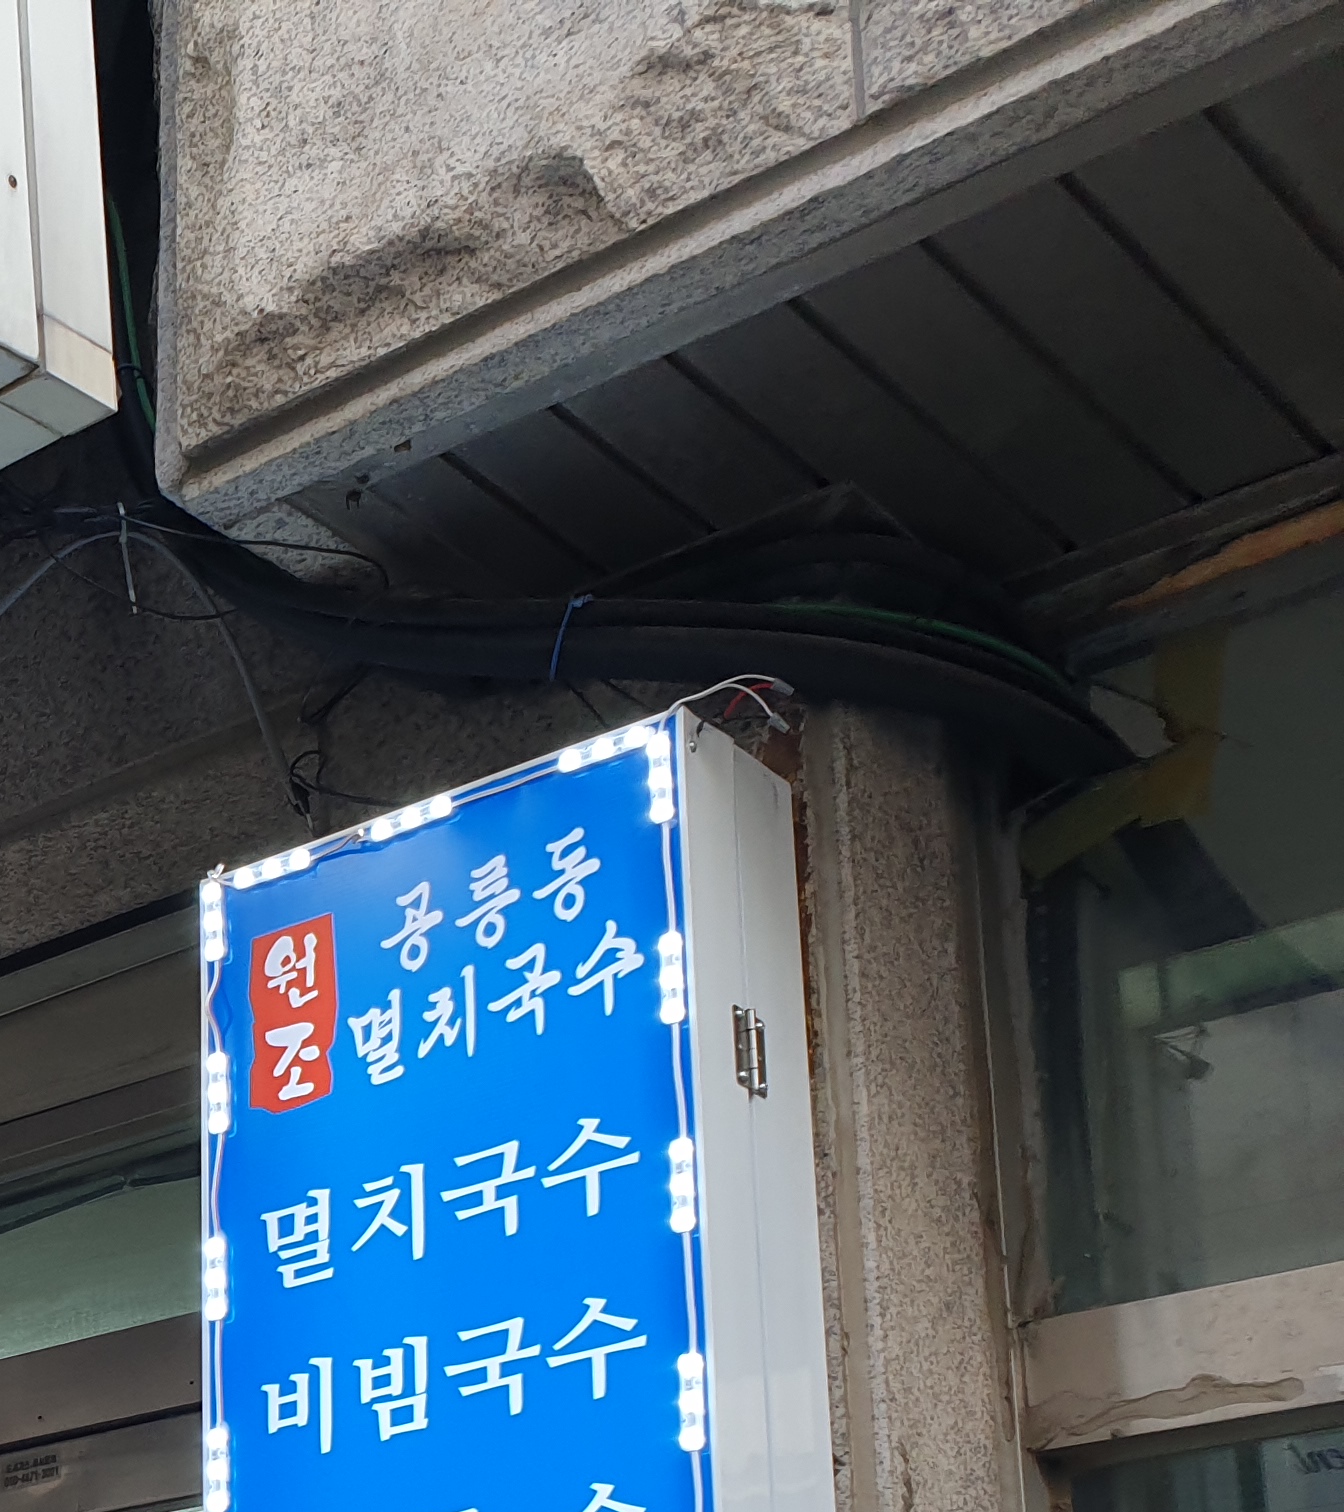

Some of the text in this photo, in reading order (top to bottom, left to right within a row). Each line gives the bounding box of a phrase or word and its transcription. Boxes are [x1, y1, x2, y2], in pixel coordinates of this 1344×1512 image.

[380, 825, 602, 972] 공릉동
[264, 930, 322, 1102] 원조
[346, 919, 646, 1087] 멸치국수
[260, 1117, 643, 1290] 멸치국수
[260, 1296, 650, 1454] 비빔국수
